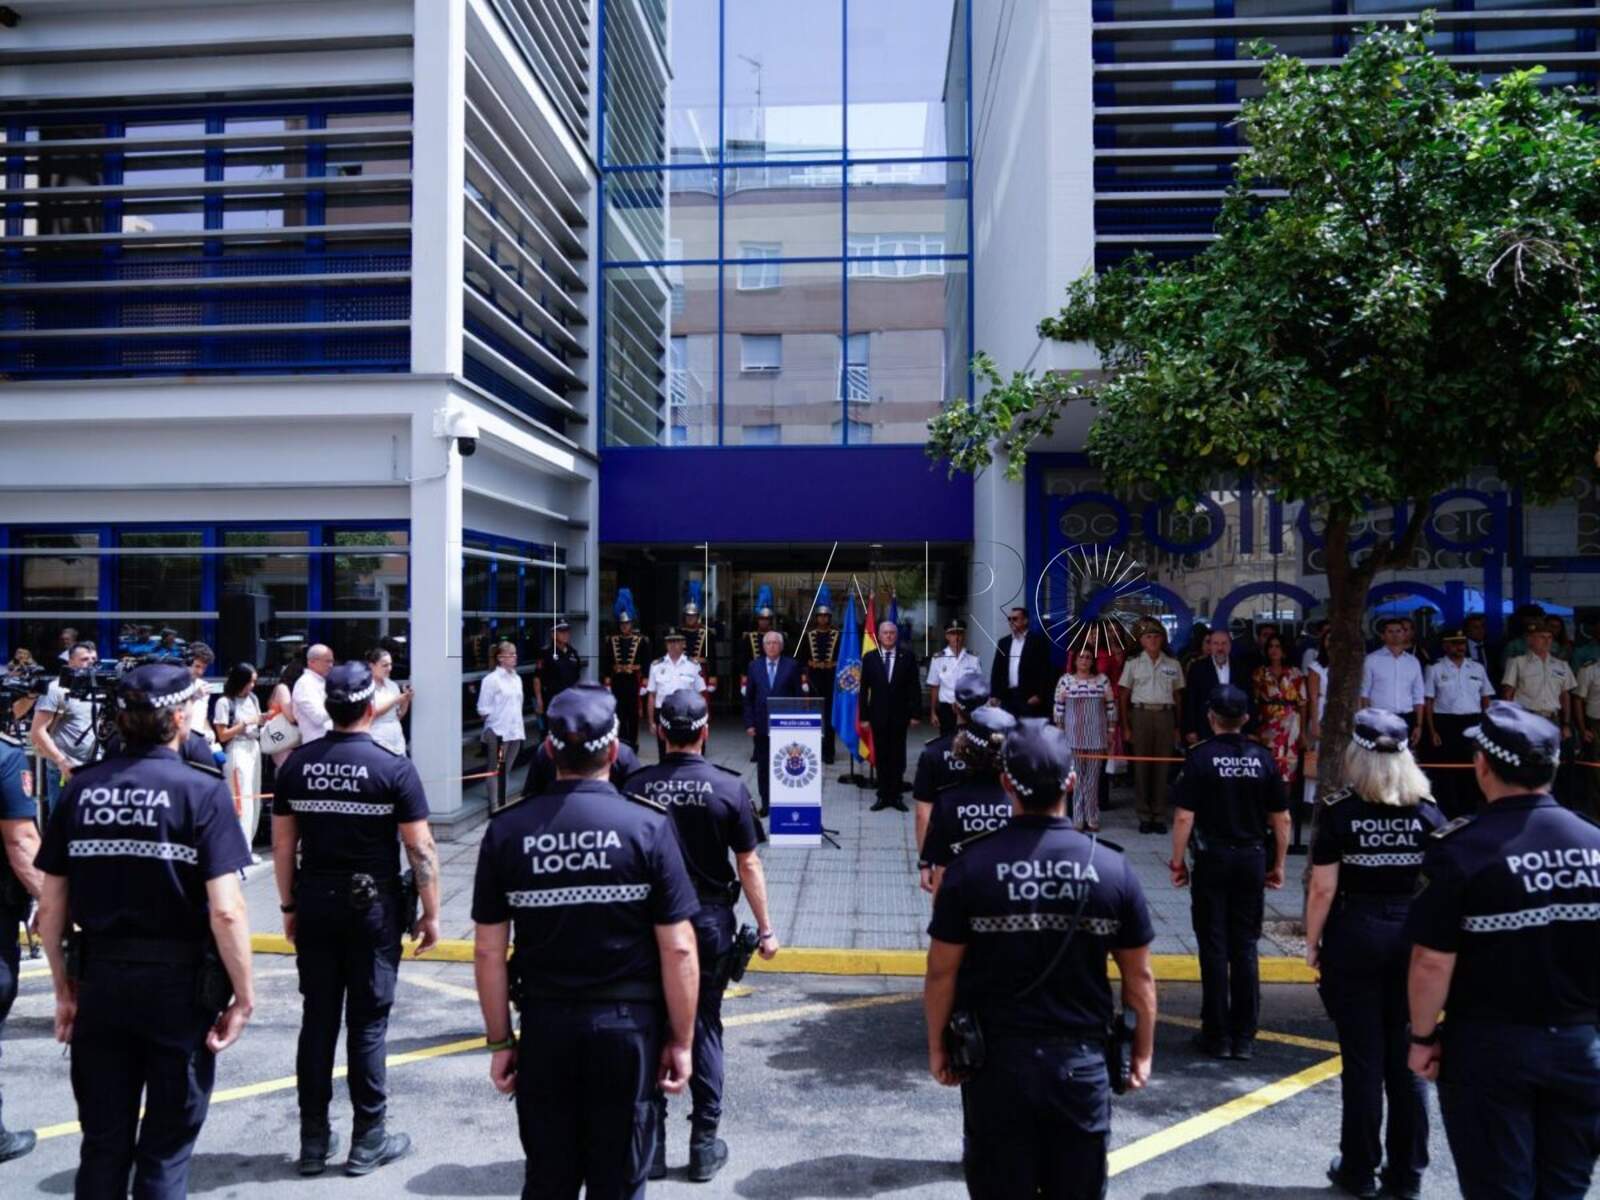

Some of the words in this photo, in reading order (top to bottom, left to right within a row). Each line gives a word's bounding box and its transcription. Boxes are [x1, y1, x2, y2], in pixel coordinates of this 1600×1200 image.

[1212, 756, 1262, 769] POLICIA
[302, 763, 369, 779] POLICIA
[1219, 766, 1259, 778] LOCAL
[307, 777, 361, 792] LOCAL
[644, 780, 713, 794] POLICIA
[78, 787, 171, 807] POLICIA
[83, 807, 159, 827] LOCAL
[957, 804, 1013, 819] POLICI
[1351, 818, 1423, 833] POLICIA
[523, 830, 622, 854] POLICIA
[1359, 832, 1419, 847] LOCAL
[532, 851, 612, 875] LOCAL
[996, 860, 1100, 883] POLICIA
